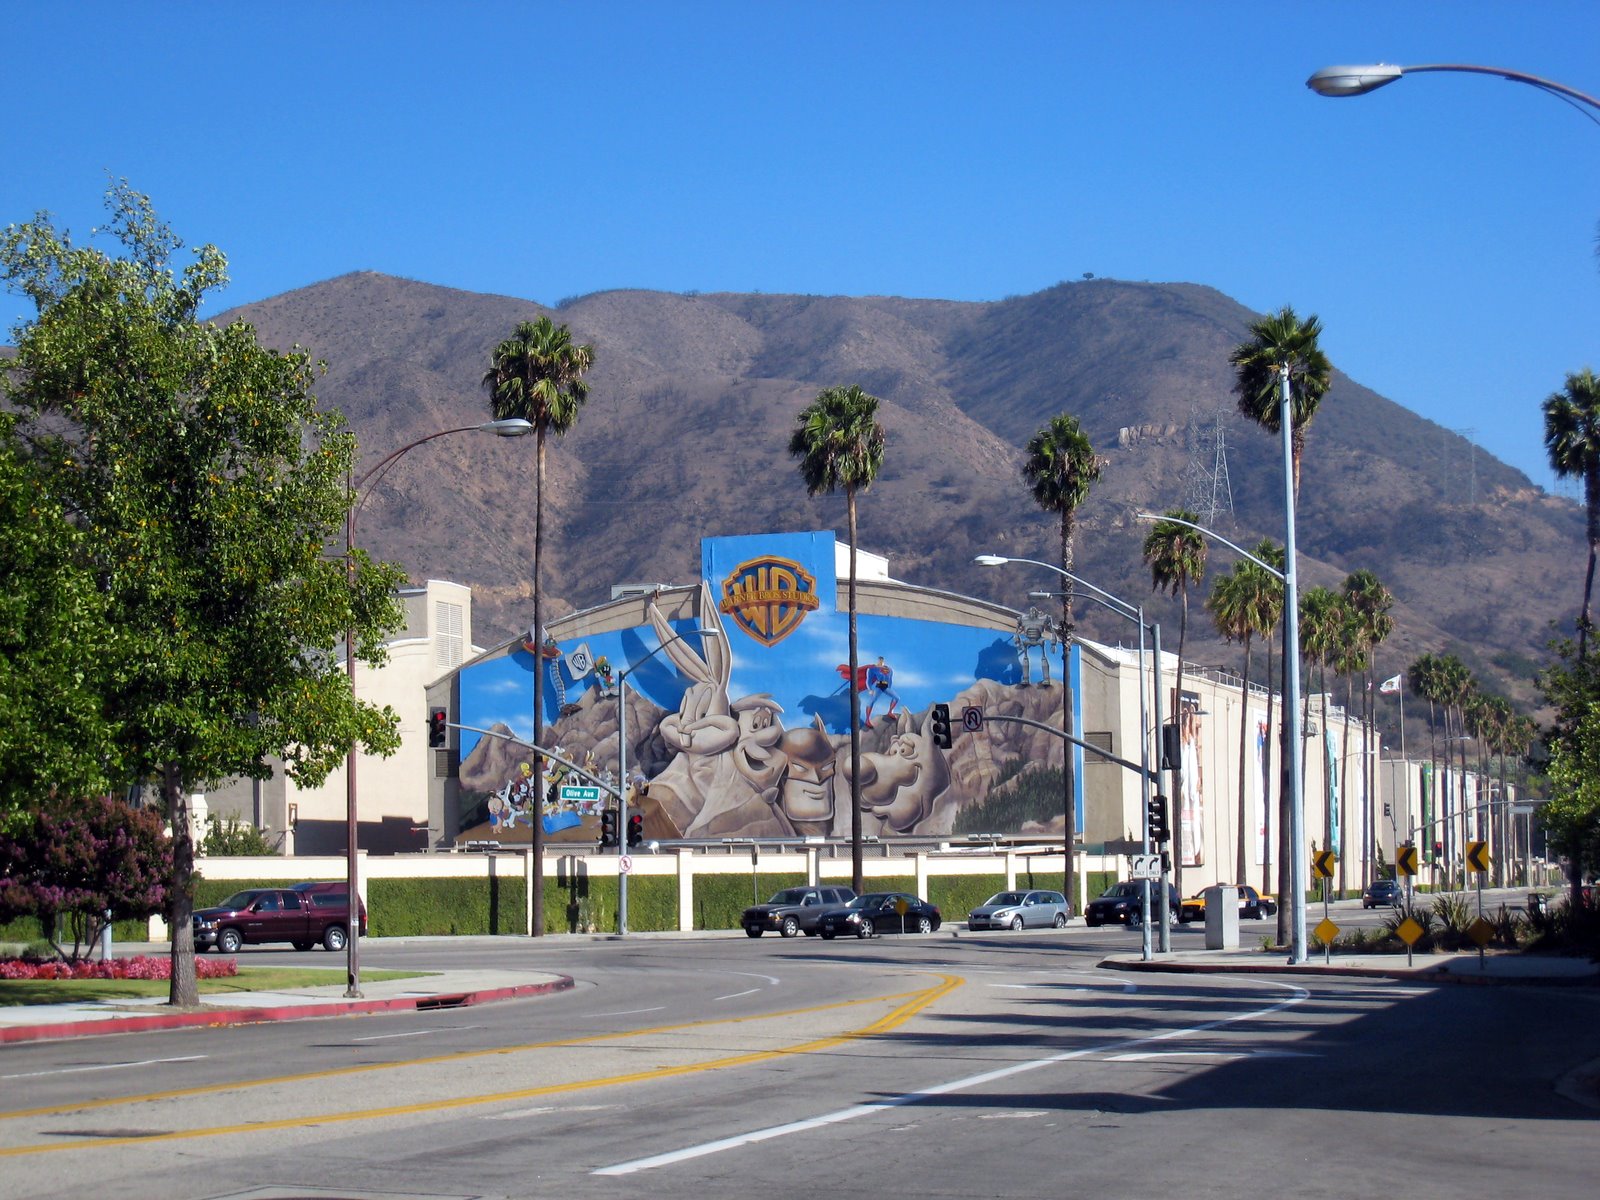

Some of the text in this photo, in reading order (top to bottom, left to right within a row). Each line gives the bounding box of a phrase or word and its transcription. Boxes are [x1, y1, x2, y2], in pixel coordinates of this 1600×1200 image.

[720, 592, 757, 608] WARNER
[782, 591, 819, 607] STUDIOS
[583, 790, 594, 798] Ave
